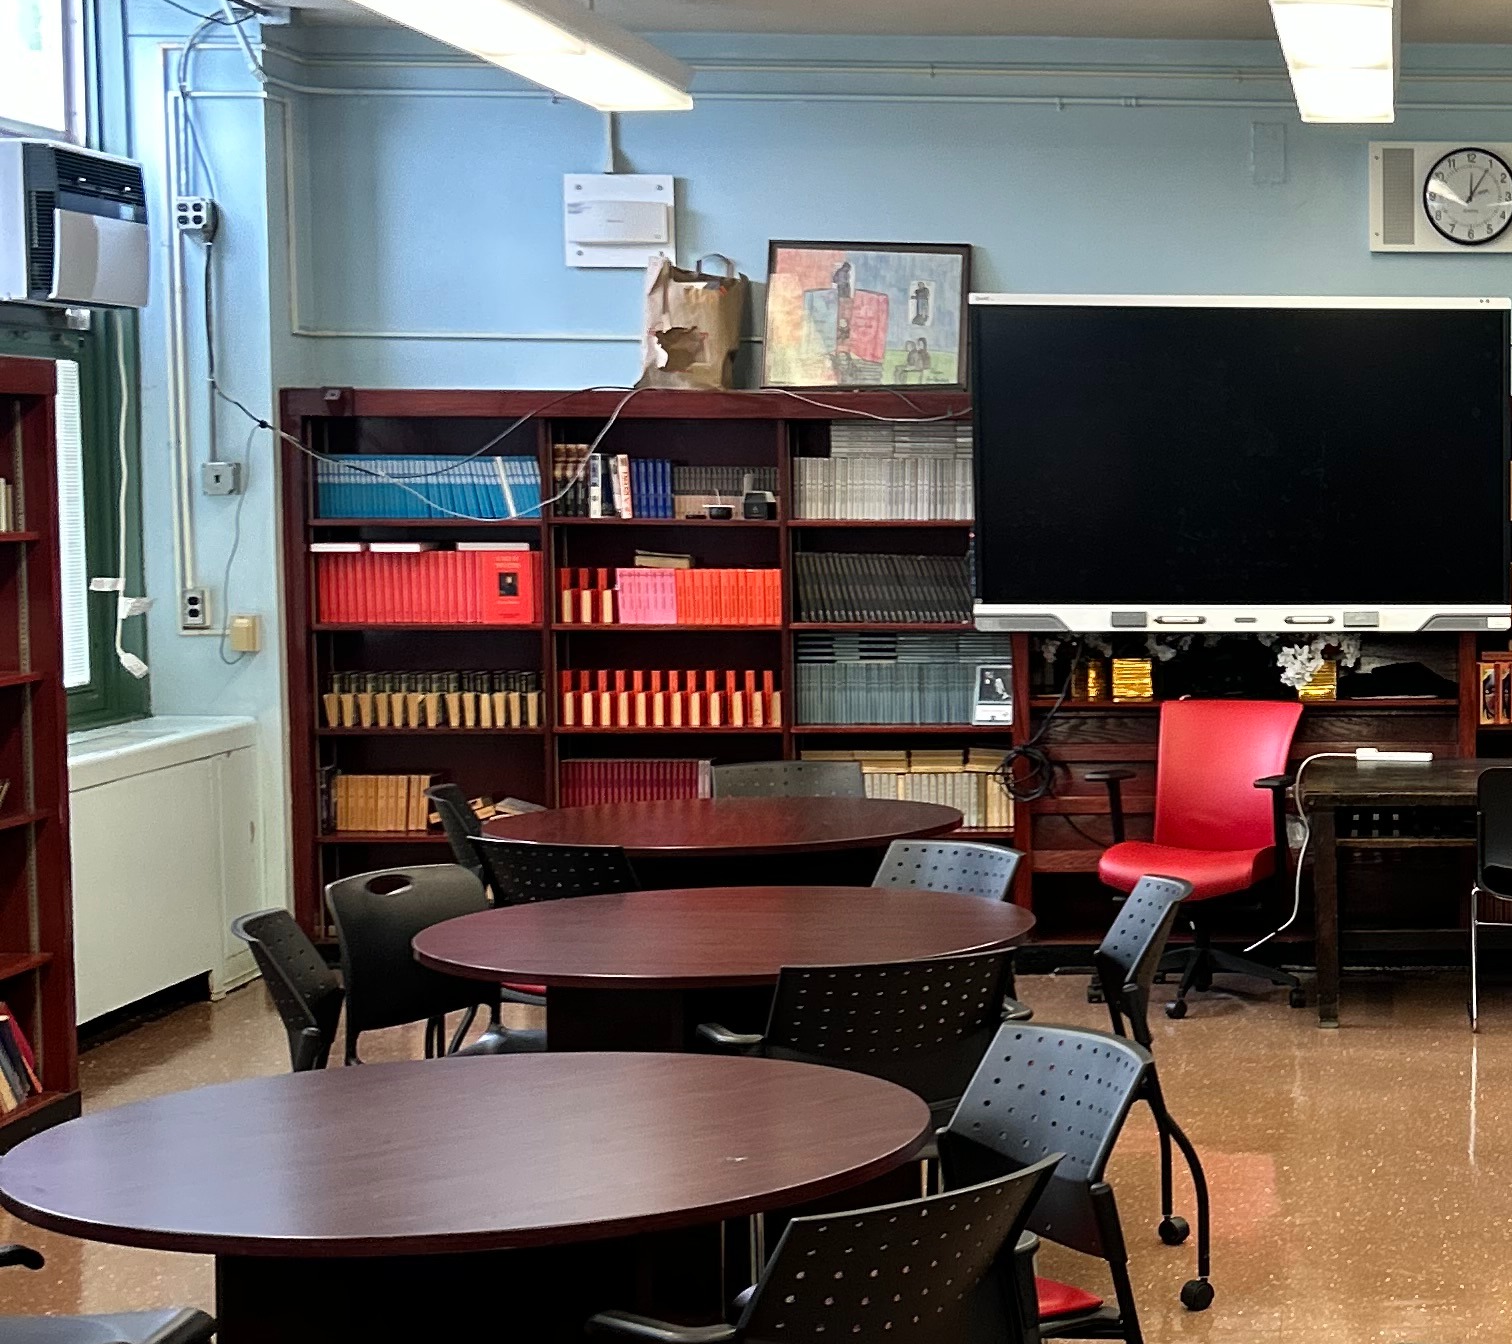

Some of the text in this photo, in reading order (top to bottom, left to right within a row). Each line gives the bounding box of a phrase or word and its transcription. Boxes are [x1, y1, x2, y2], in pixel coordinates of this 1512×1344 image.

[1447, 158, 1456, 168] 11
[1467, 153, 1477, 163] 12
[1488, 159, 1493, 168] 1
[1500, 172, 1507, 183] 2
[1428, 192, 1436, 201] 9
[1504, 191, 1512, 202] 3
[1435, 210, 1442, 221] 8
[1500, 210, 1506, 219] 4
[1449, 224, 1456, 233] 7
[1486, 223, 1493, 234] 5
[1467, 229, 1474, 239] 6
